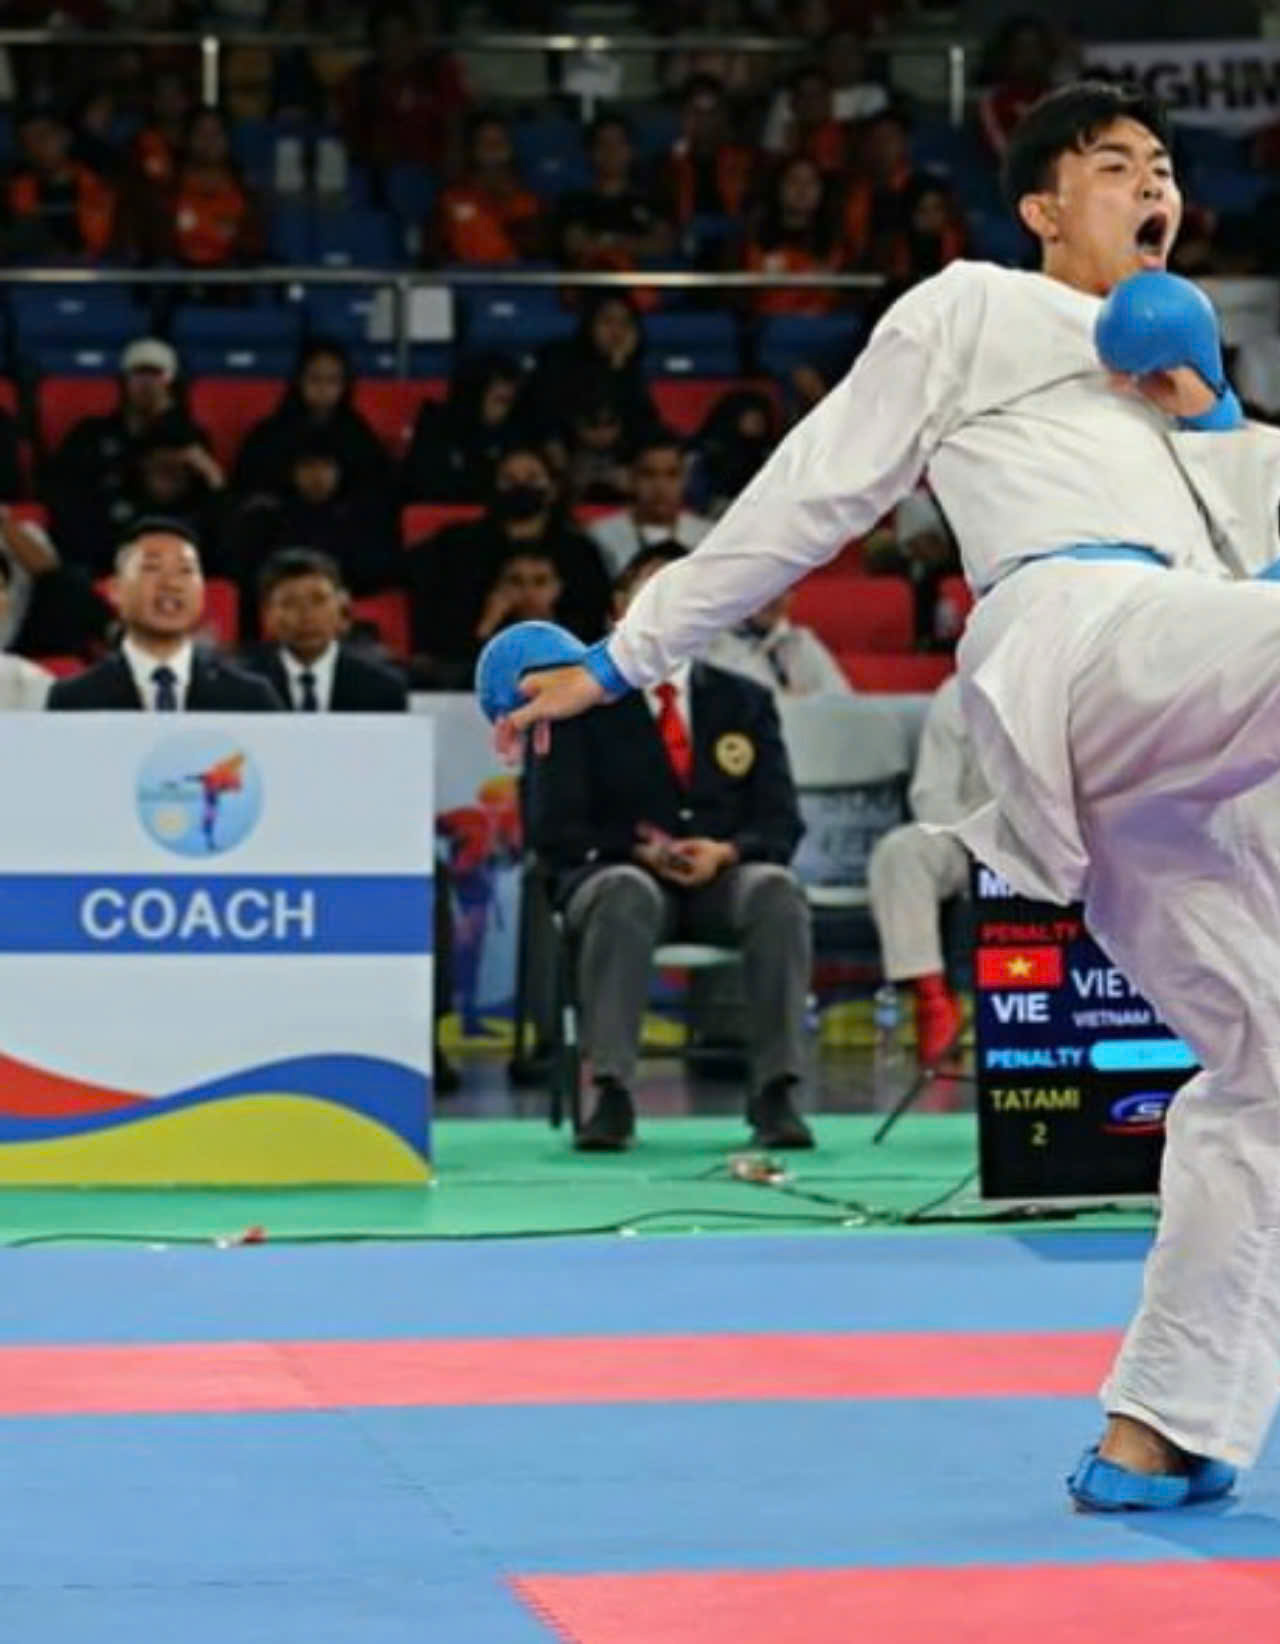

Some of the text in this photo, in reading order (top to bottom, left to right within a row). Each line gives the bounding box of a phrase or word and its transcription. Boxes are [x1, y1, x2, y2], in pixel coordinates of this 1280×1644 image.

[81, 888, 315, 940] COACH
[1071, 969, 1138, 998] VIE
[991, 993, 1048, 1023] VIE
[986, 1048, 1082, 1070] PENALTY
[991, 1089, 1080, 1111] TATAMI
[1031, 1121, 1047, 1145] 2
